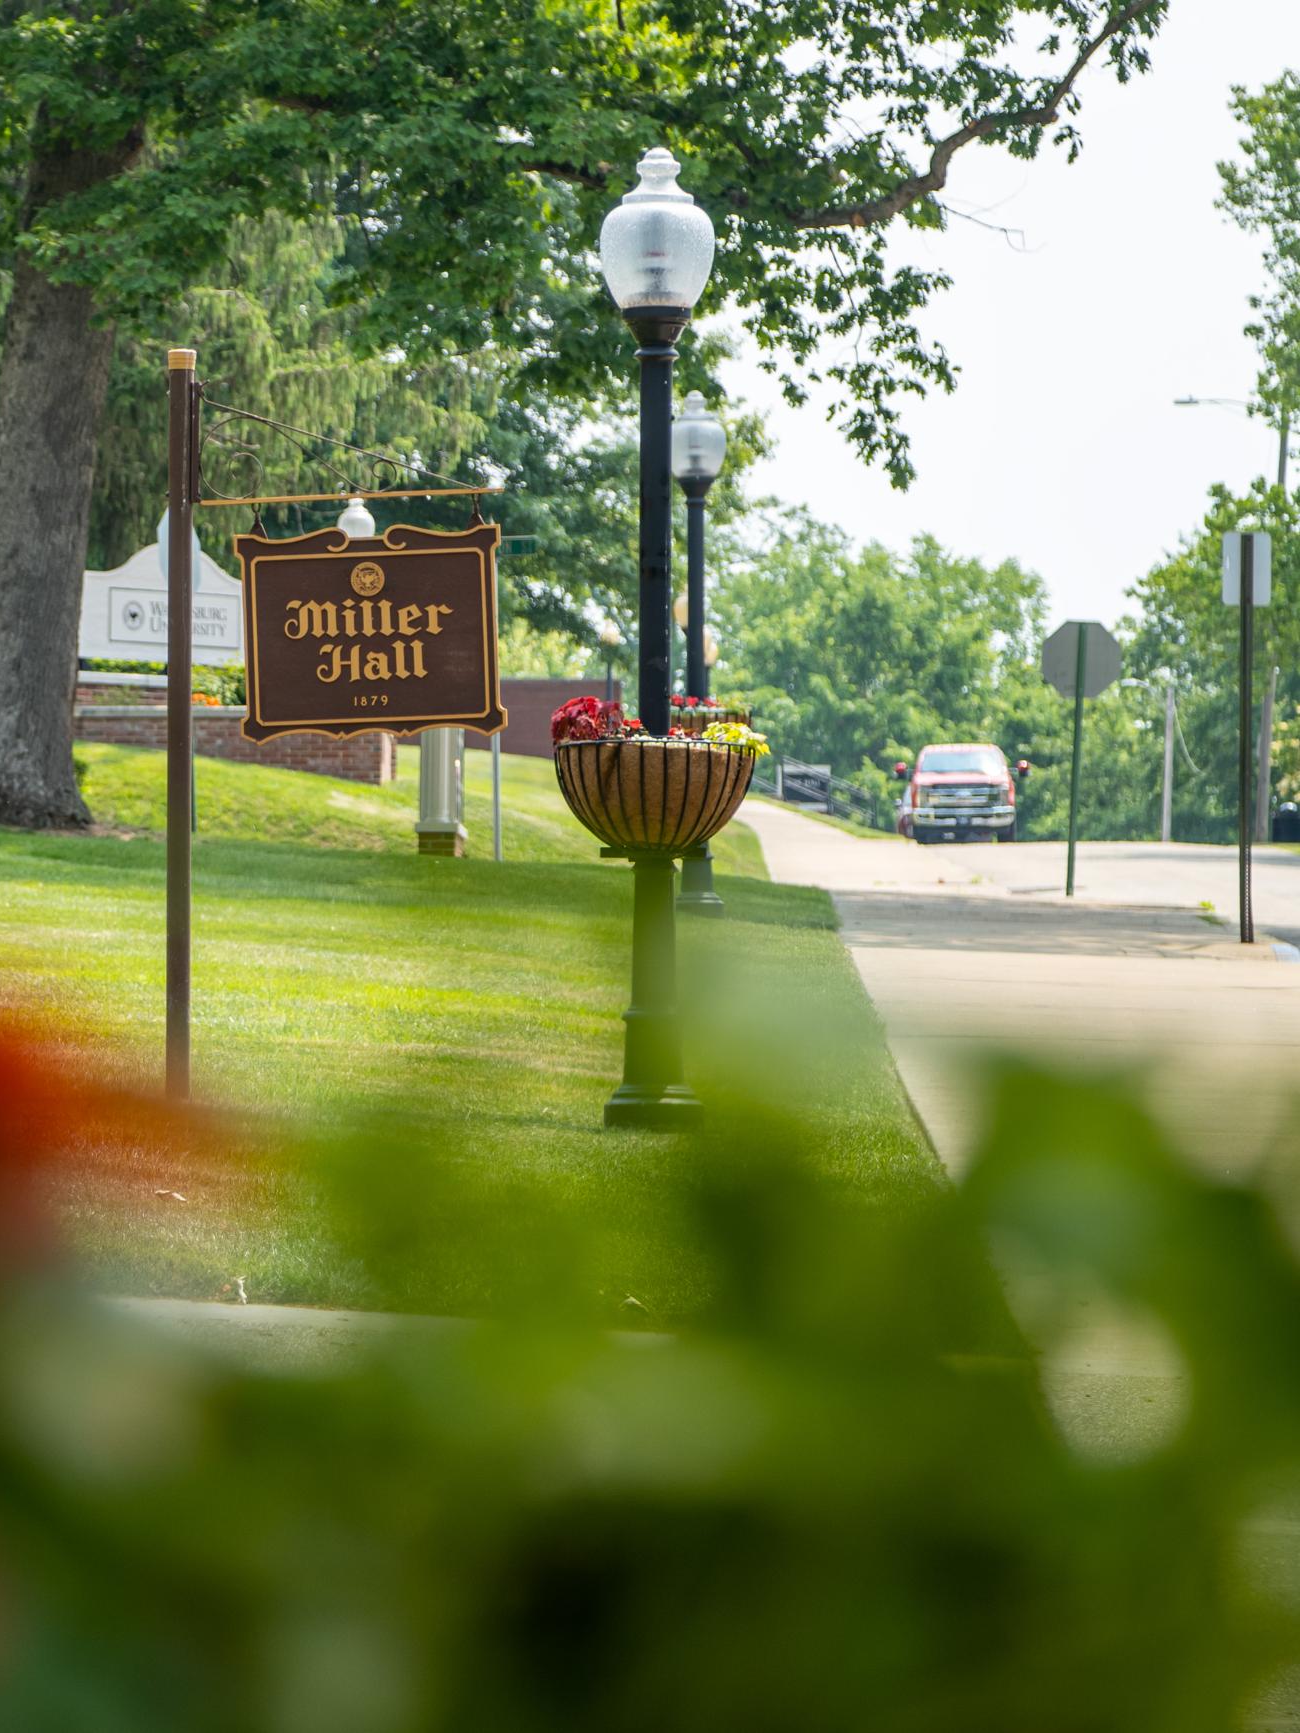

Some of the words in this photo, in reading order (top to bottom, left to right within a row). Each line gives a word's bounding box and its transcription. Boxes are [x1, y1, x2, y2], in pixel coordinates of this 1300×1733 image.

[284, 599, 455, 640] Miller
[316, 640, 429, 683] Hall
[353, 695, 390, 707] 1879
